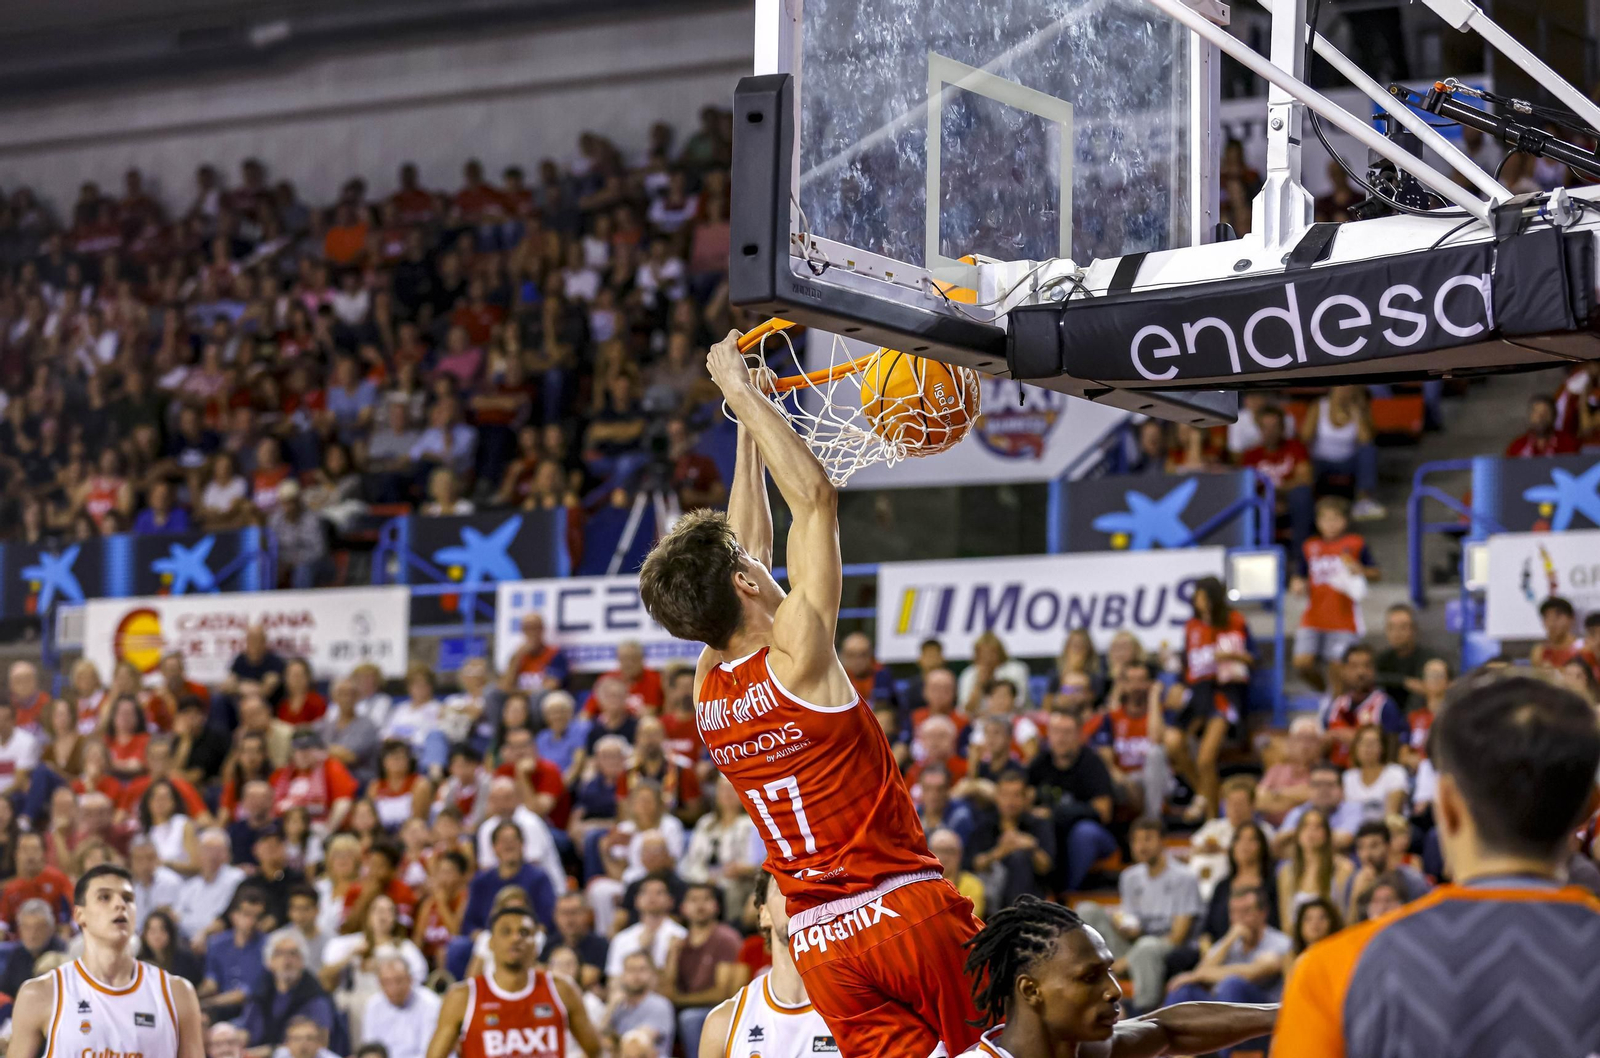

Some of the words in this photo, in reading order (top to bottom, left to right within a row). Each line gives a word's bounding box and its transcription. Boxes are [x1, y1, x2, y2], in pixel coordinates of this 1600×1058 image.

[1130, 273, 1495, 381] endesa
[933, 382, 948, 406] liga
[708, 721, 803, 766] inmoovs
[766, 754, 775, 763] by
[776, 738, 811, 759] AVINENT
[744, 774, 818, 862] 17
[482, 1025, 559, 1057] BAXI
